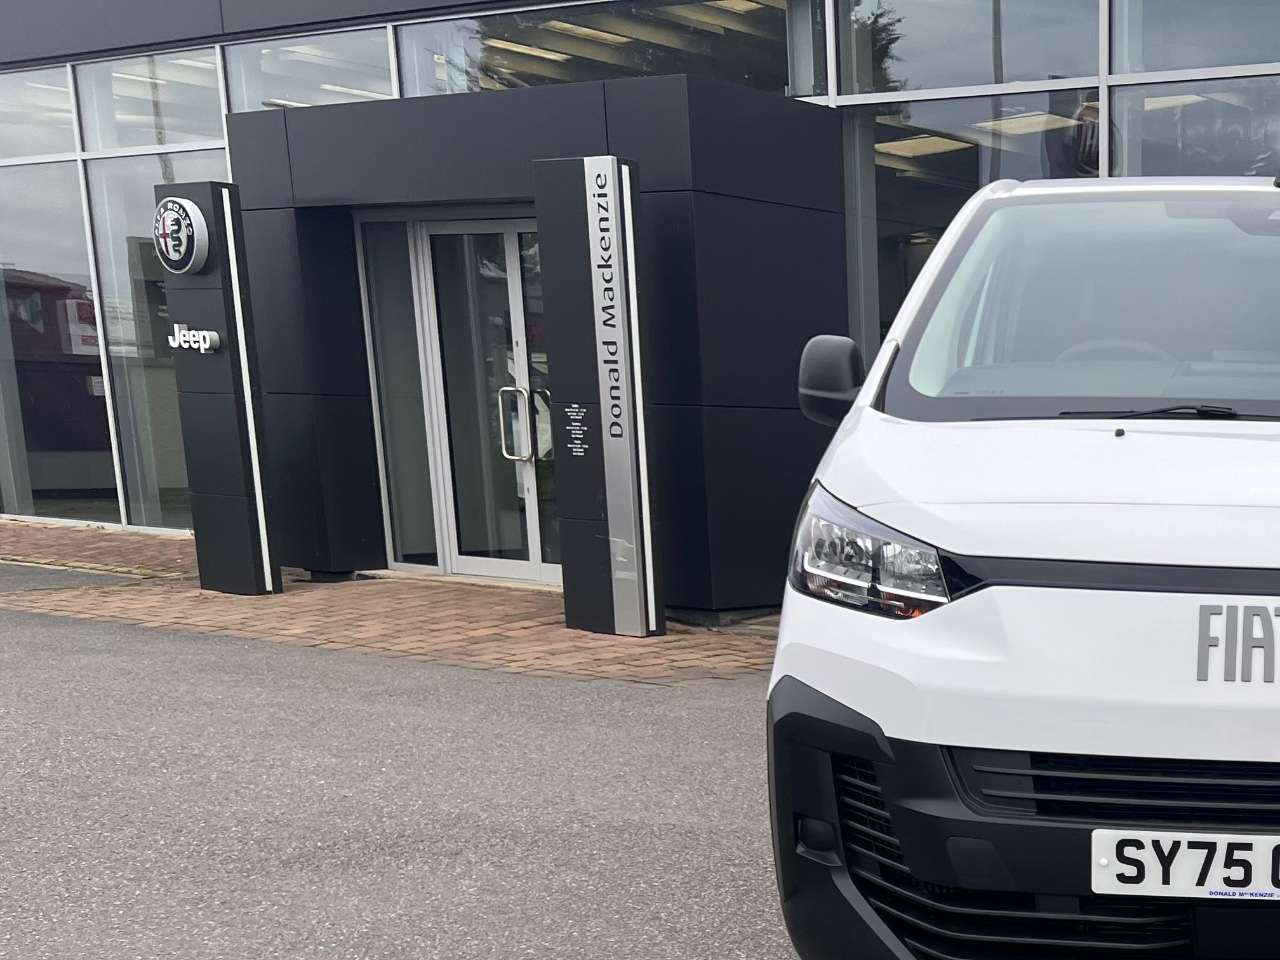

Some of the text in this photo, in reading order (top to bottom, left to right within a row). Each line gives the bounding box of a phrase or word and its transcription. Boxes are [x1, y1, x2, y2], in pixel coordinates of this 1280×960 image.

[593, 172, 624, 439] Donald Mackenzie
[167, 323, 212, 354] Jeep
[1115, 838, 1254, 889] SY75
